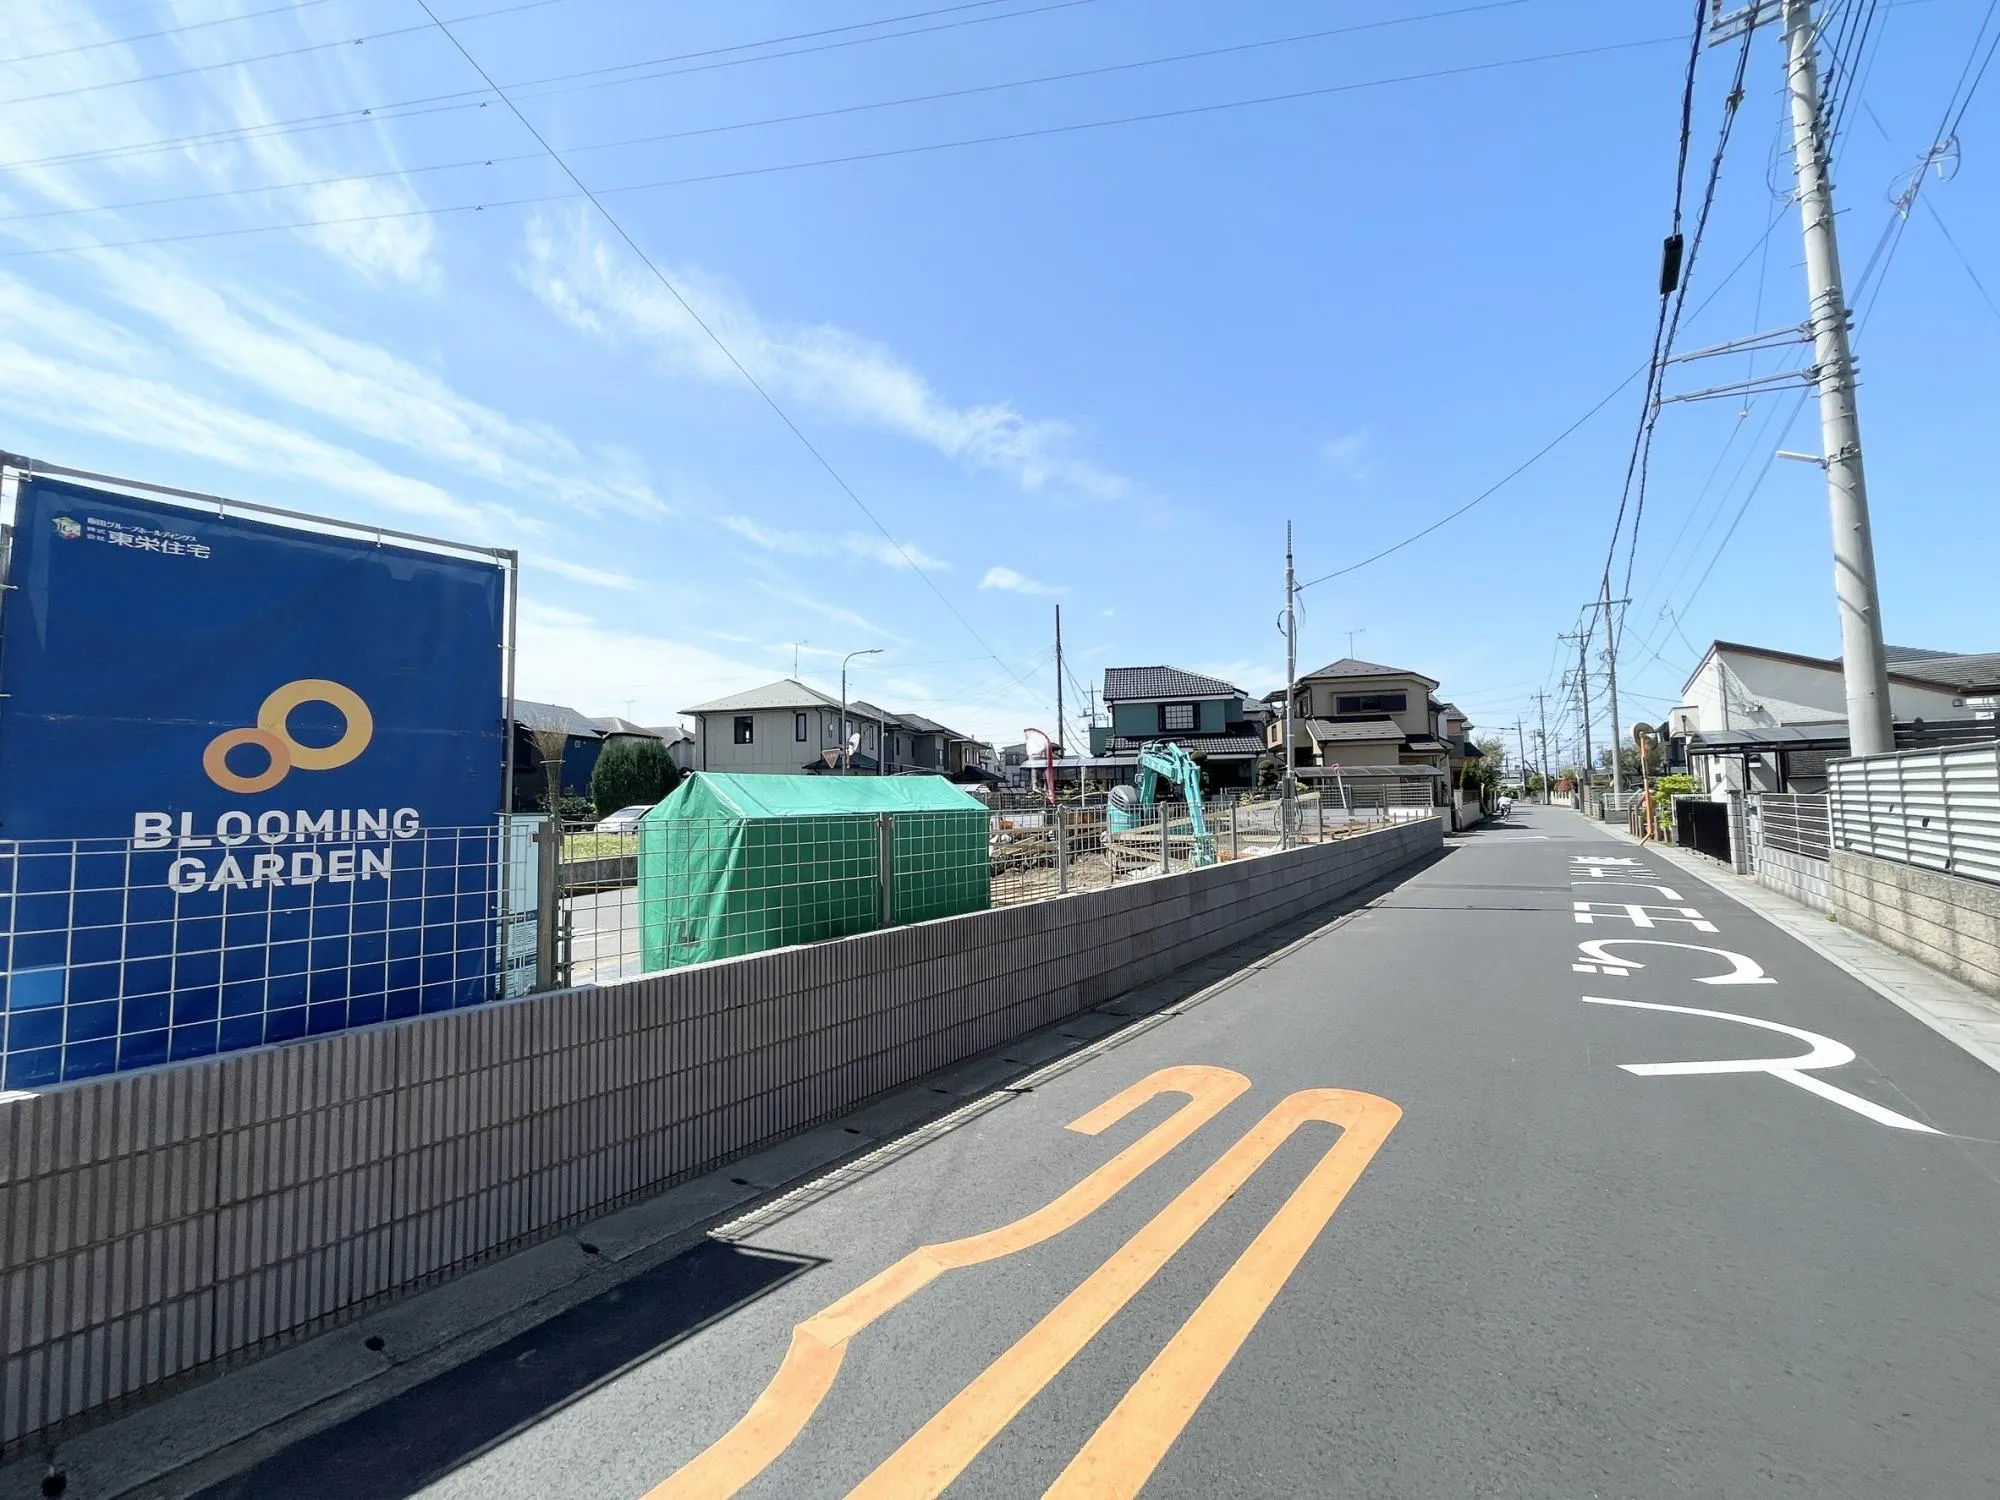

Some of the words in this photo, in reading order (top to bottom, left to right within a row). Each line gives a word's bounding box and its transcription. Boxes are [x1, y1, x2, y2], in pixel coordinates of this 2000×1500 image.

[108, 530, 211, 559] 東栄住宅
[133, 807, 420, 849] BLOOMING
[168, 847, 392, 894] GARDEN
[636, 1064, 1404, 1500] 30
